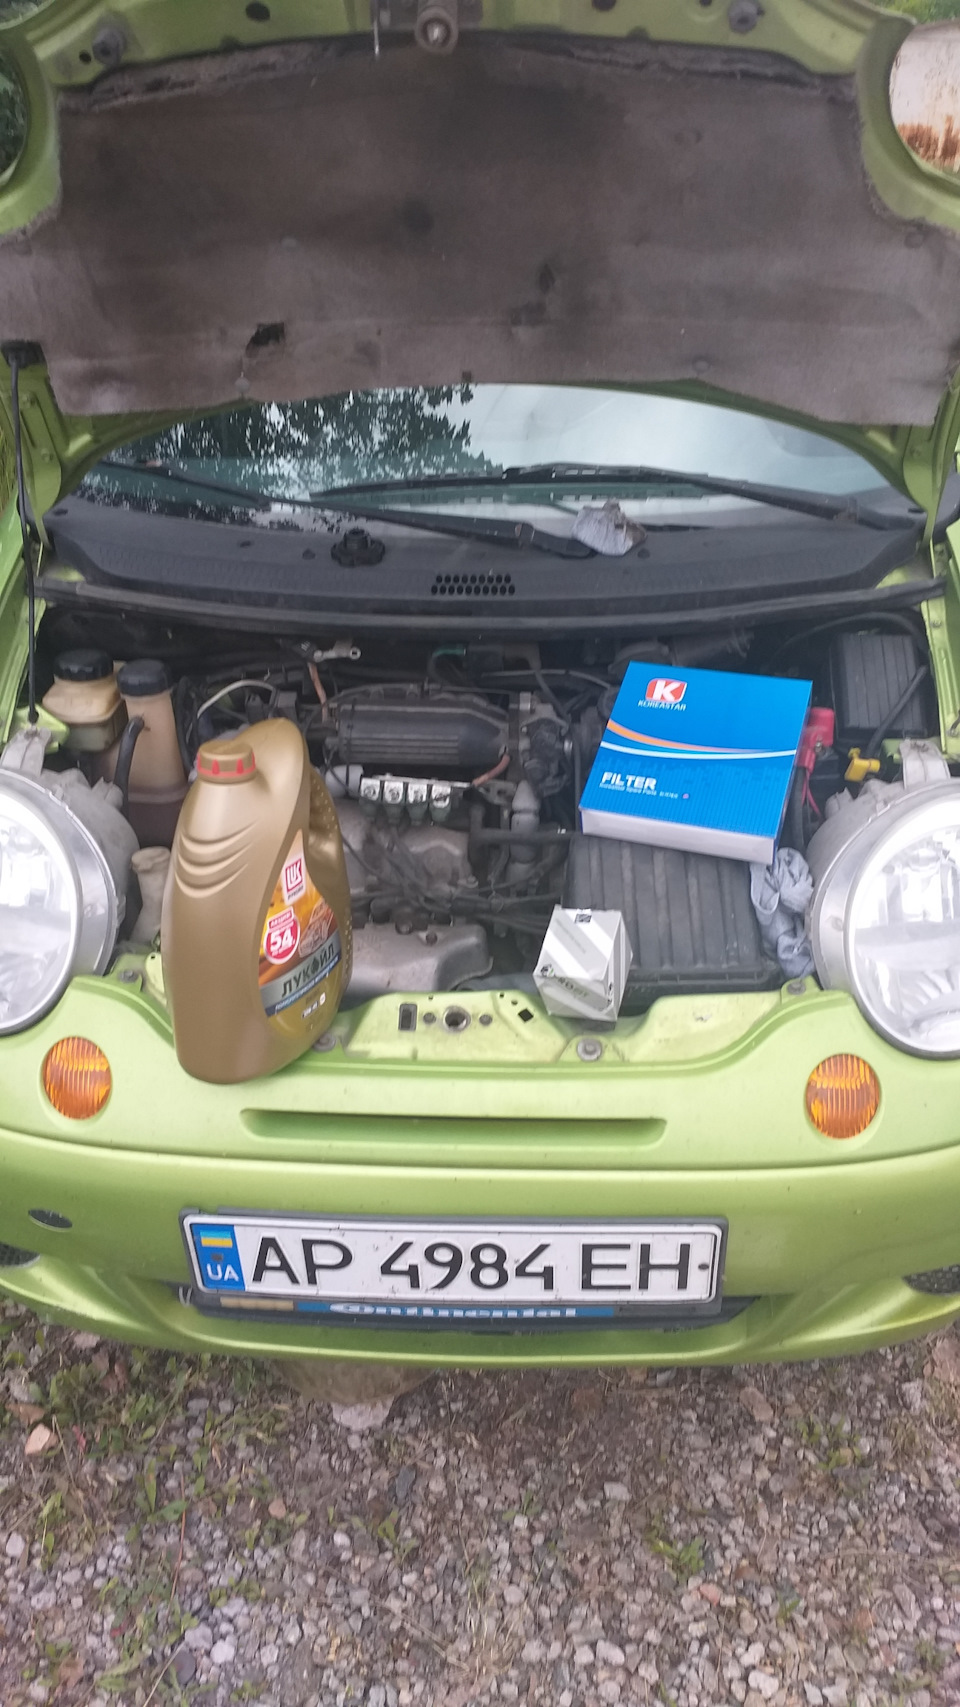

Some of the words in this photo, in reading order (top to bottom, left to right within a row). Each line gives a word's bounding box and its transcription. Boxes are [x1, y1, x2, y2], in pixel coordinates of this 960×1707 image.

[652, 679, 682, 702] K
[637, 700, 687, 711] KOREASTAR
[601, 771, 657, 790] FILTER
[281, 943, 335, 998] ЛУКОЙЛ
[206, 1263, 240, 1282] UA
[252, 1236, 353, 1286] AP
[380, 1241, 554, 1291] 4984
[581, 1243, 691, 1291] EH
